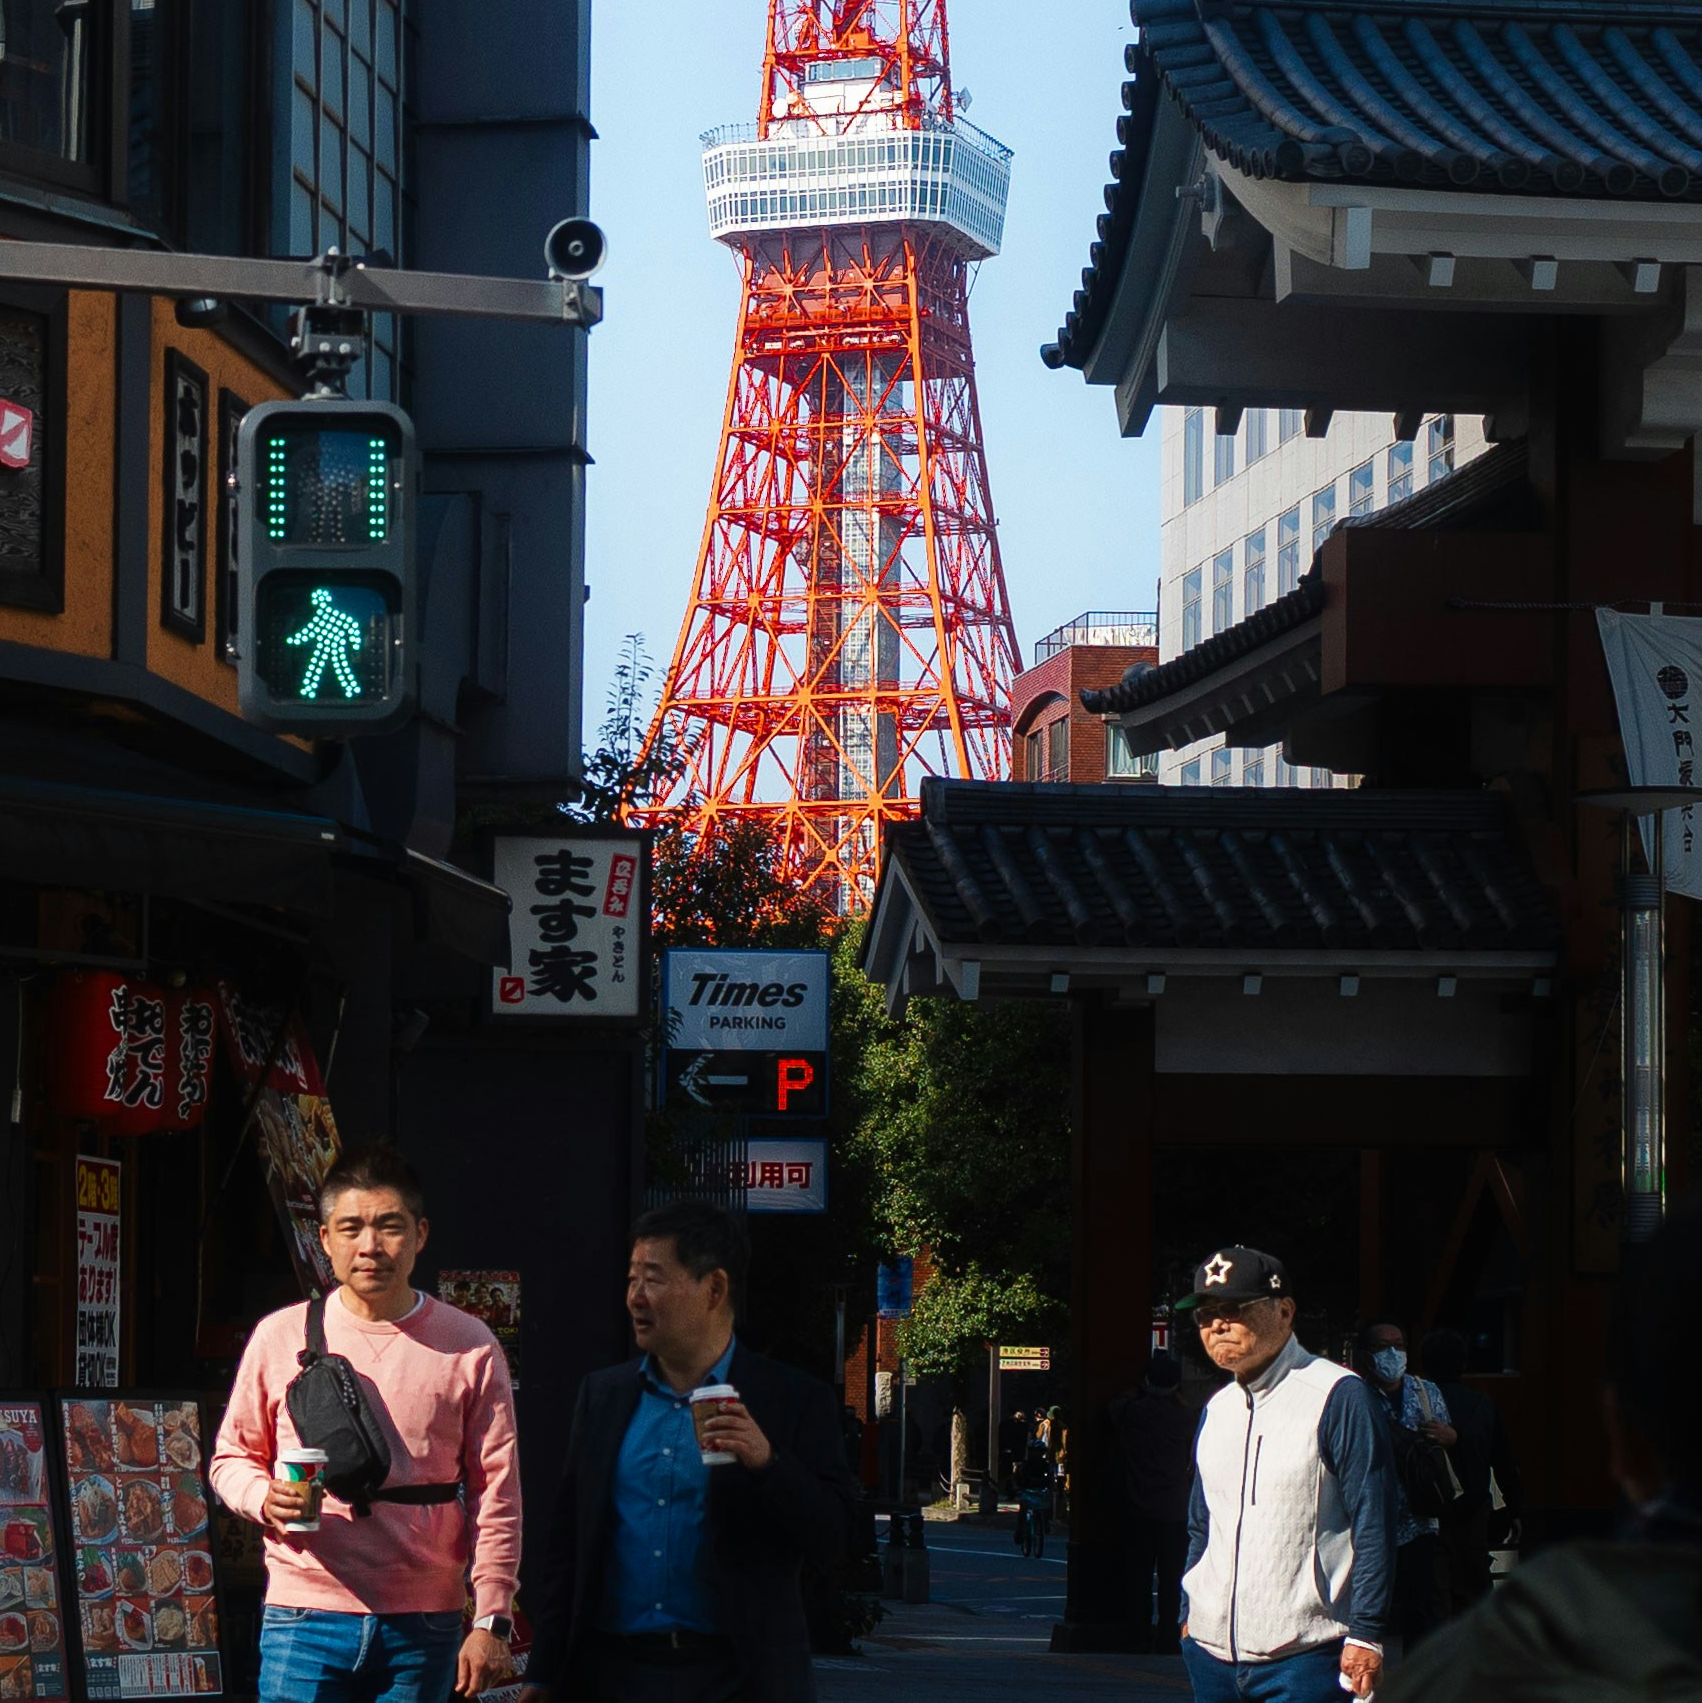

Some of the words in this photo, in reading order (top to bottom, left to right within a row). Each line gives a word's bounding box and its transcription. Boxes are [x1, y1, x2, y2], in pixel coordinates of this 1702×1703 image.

[527, 849, 598, 1002] ます家
[689, 973, 808, 1007] Times
[710, 1015, 786, 1030] PARKING
[123, 995, 166, 1109] おでん
[777, 1058, 814, 1111] P
